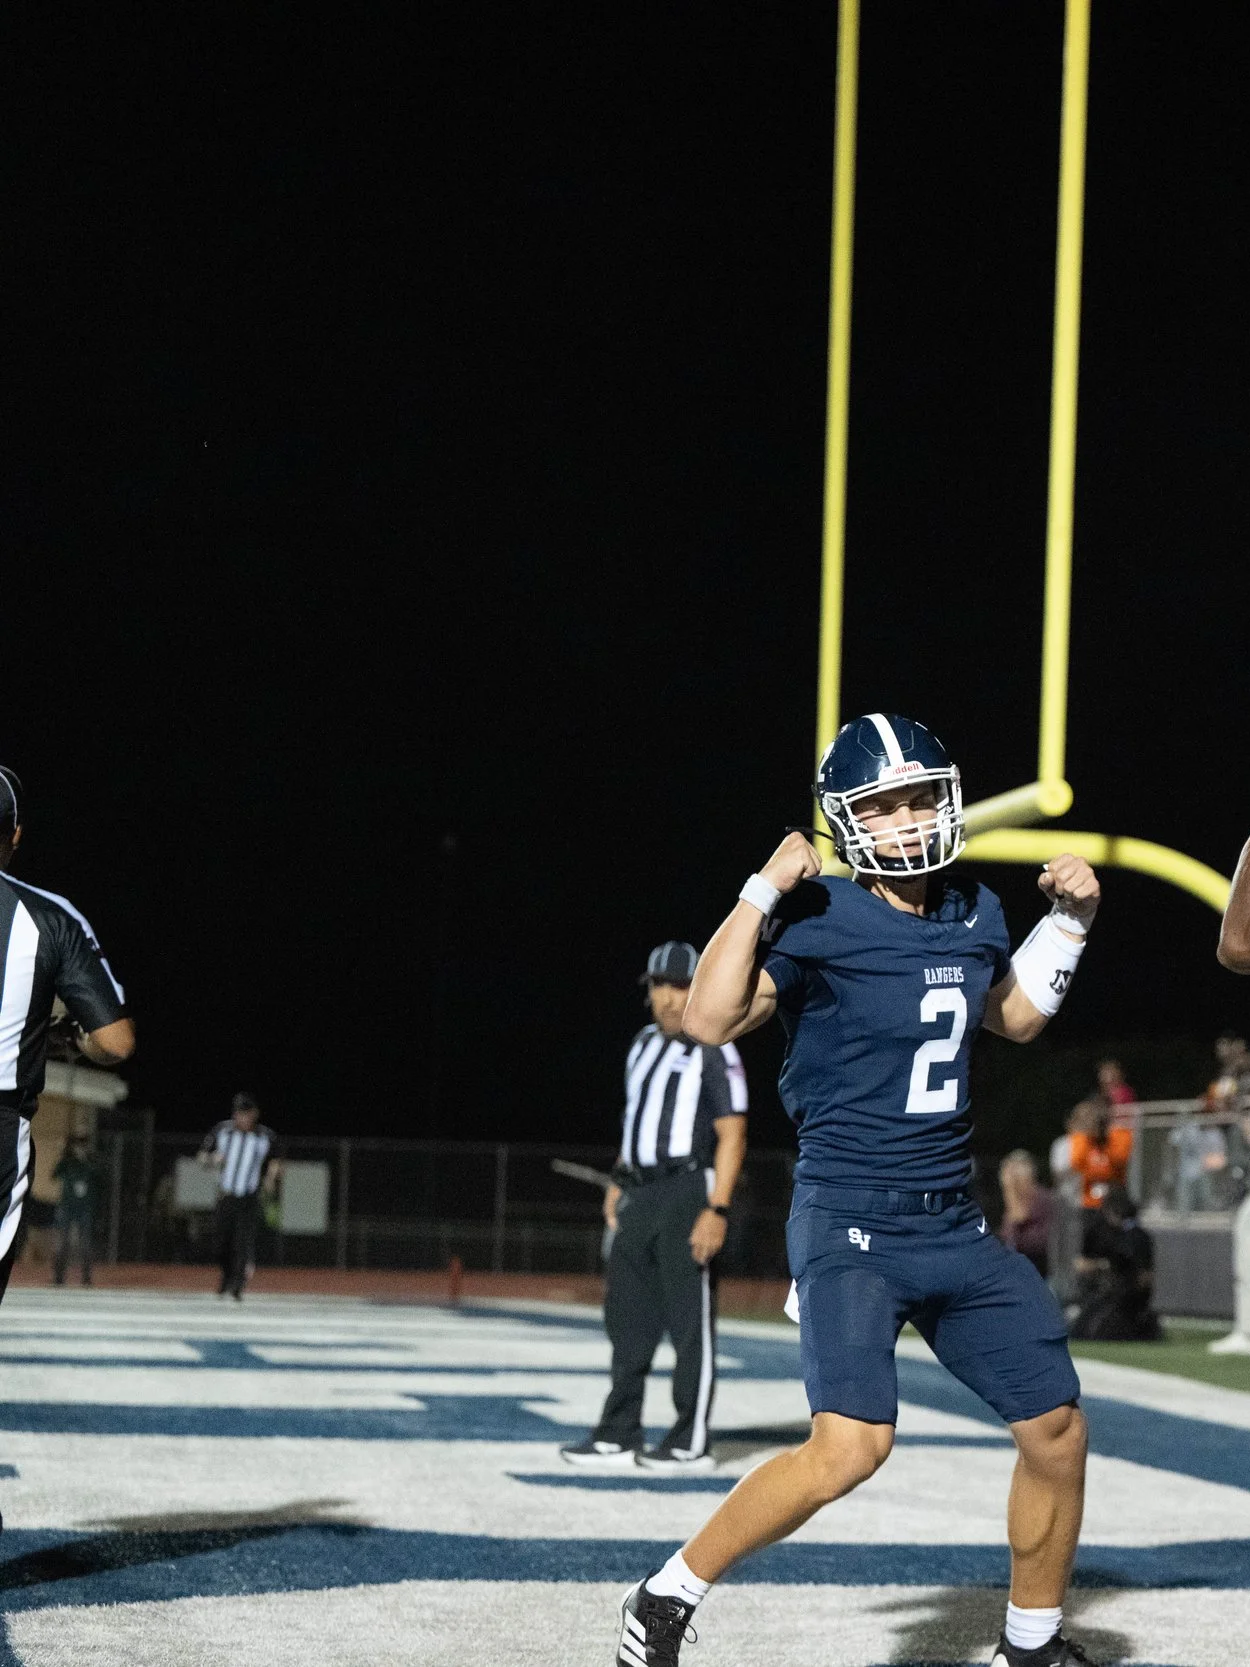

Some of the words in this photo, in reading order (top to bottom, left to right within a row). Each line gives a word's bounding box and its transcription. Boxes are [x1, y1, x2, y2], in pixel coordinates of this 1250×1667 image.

[924, 967, 965, 985] RANGERS
[905, 987, 967, 1114] 2
[848, 1227, 871, 1251] SV
